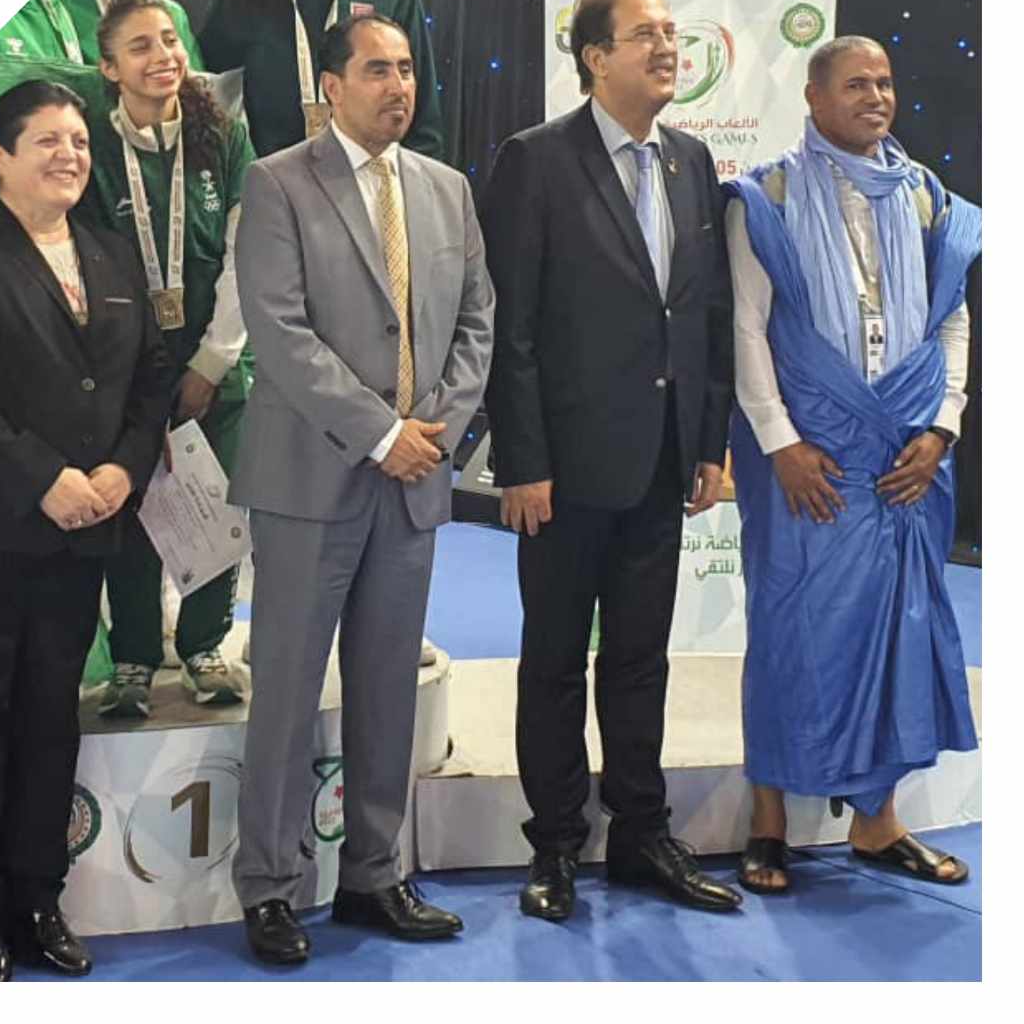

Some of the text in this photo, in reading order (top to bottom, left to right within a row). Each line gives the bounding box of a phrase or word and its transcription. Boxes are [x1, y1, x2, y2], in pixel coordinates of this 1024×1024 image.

[710, 133, 759, 145] GAMES
[716, 159, 736, 175] 05
[695, 558, 735, 581] نلتقي
[171, 780, 210, 858] 1
